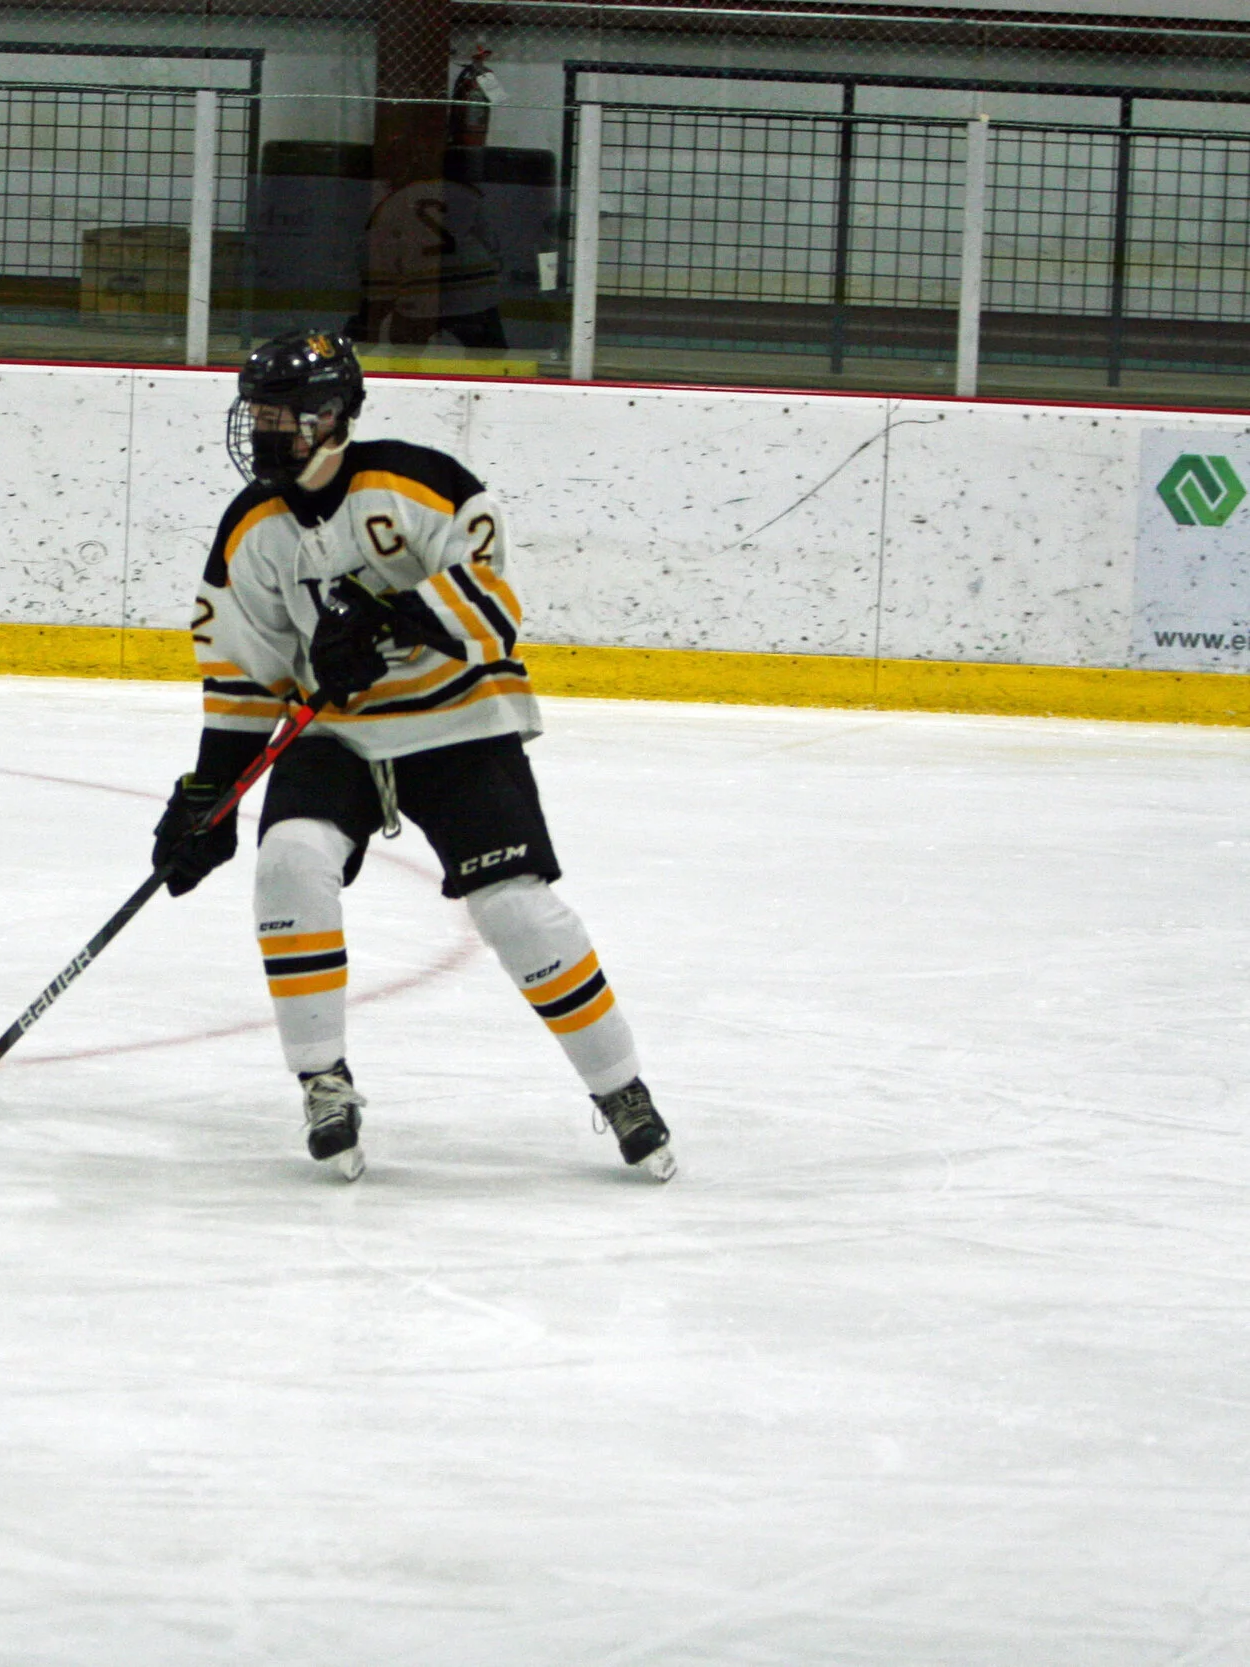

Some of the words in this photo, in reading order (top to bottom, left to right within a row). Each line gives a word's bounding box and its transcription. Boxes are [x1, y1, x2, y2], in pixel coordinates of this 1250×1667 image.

[365, 514, 406, 557] C
[467, 513, 496, 563] 2
[459, 843, 528, 876] CCM
[17, 947, 91, 1031] BAUER
